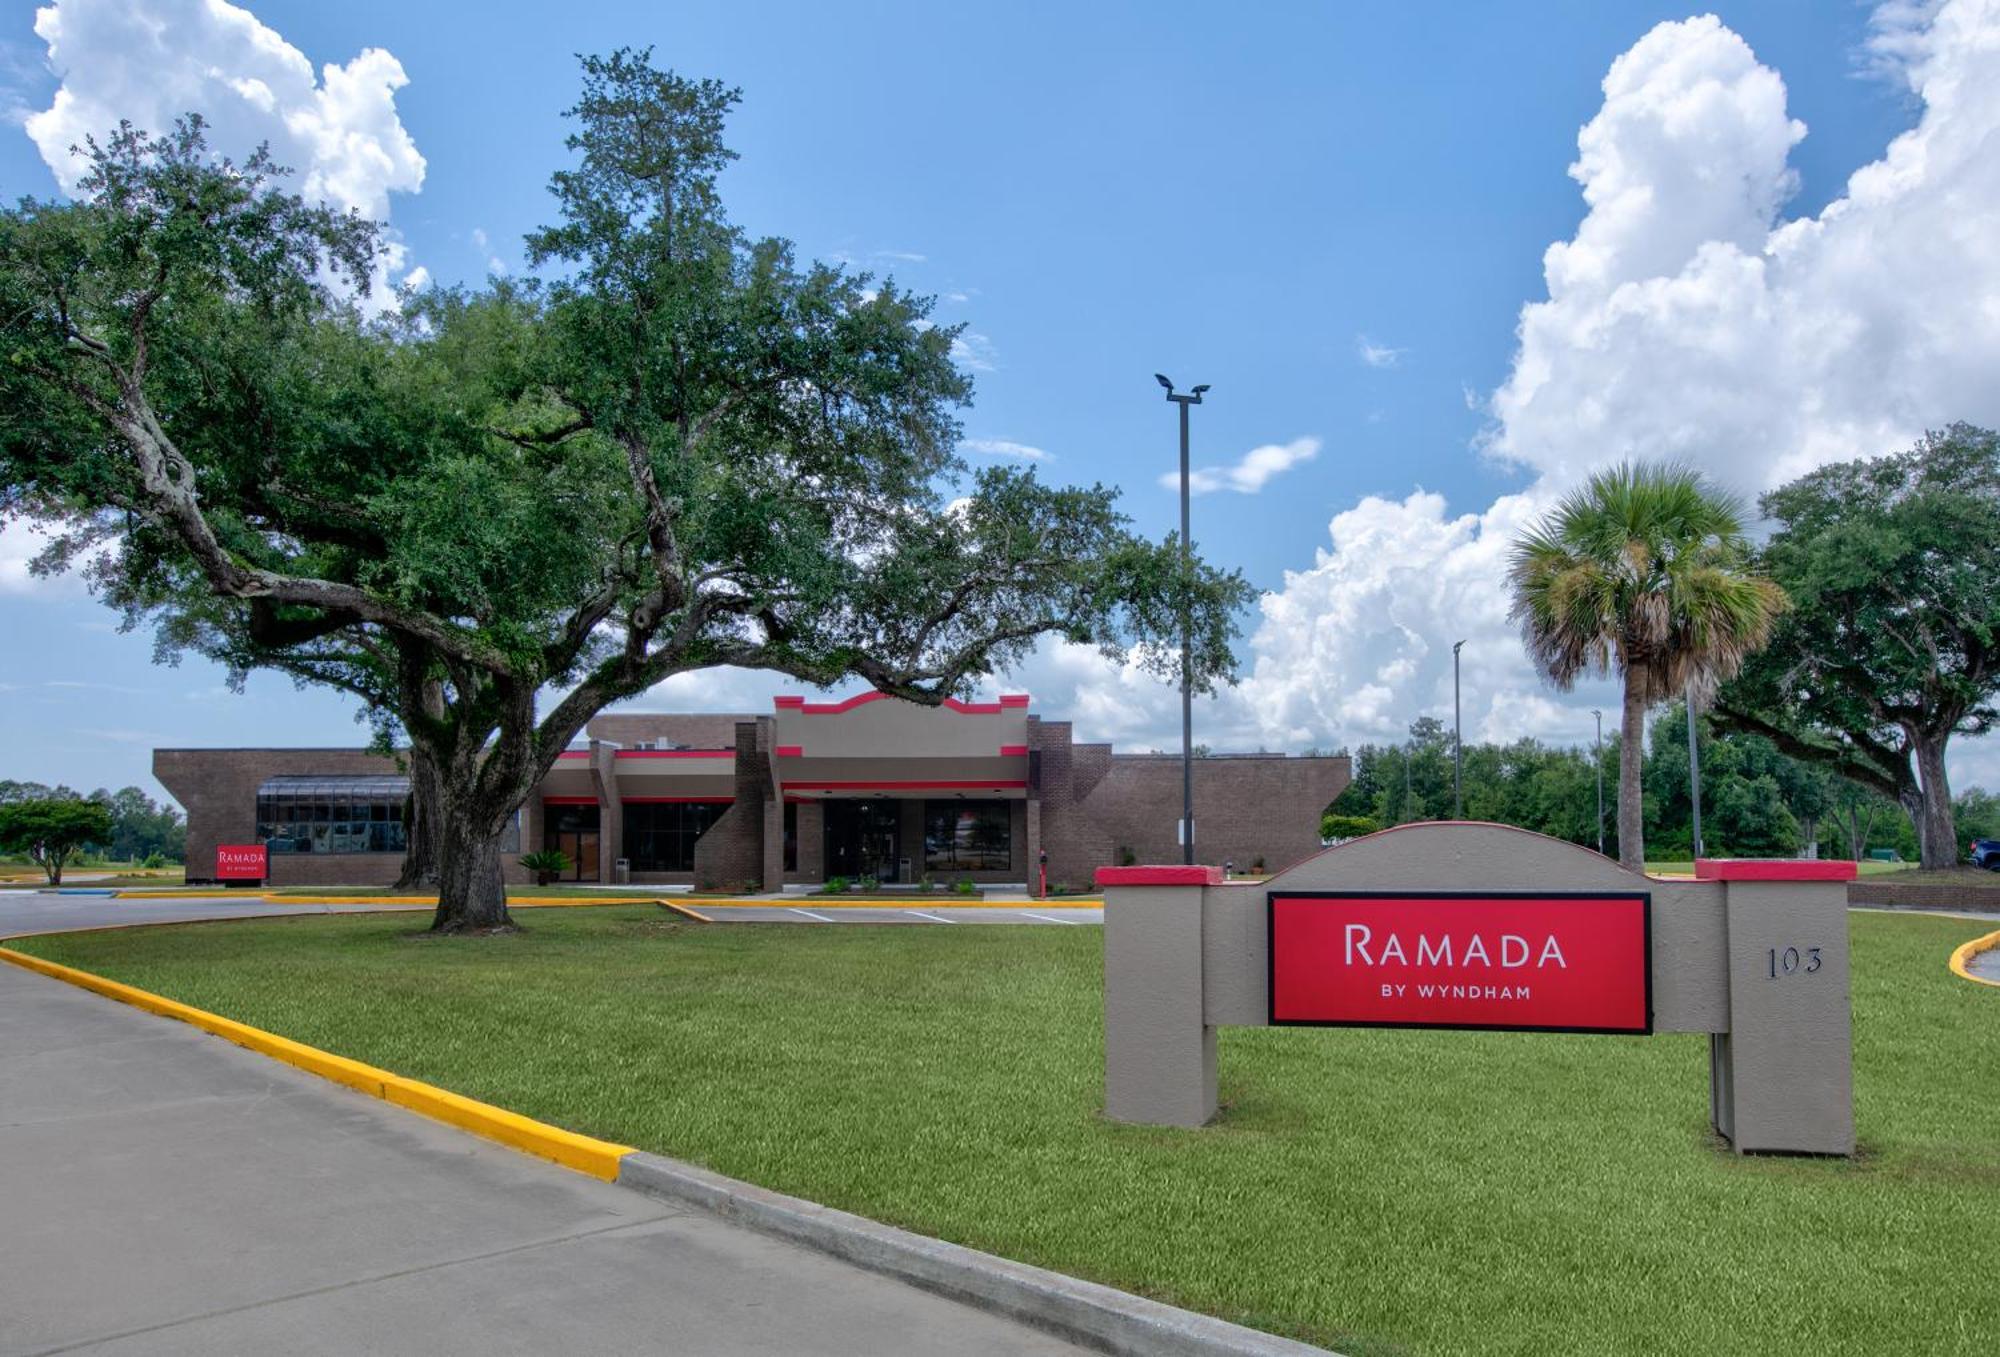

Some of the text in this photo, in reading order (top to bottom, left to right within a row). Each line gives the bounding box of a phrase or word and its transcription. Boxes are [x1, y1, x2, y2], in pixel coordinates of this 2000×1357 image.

[219, 851, 265, 863] RAMADA
[1344, 923, 1567, 968] RAMADA
[1768, 946, 1822, 978] 103
[1381, 984, 1530, 1000] BY WYNDHAM
